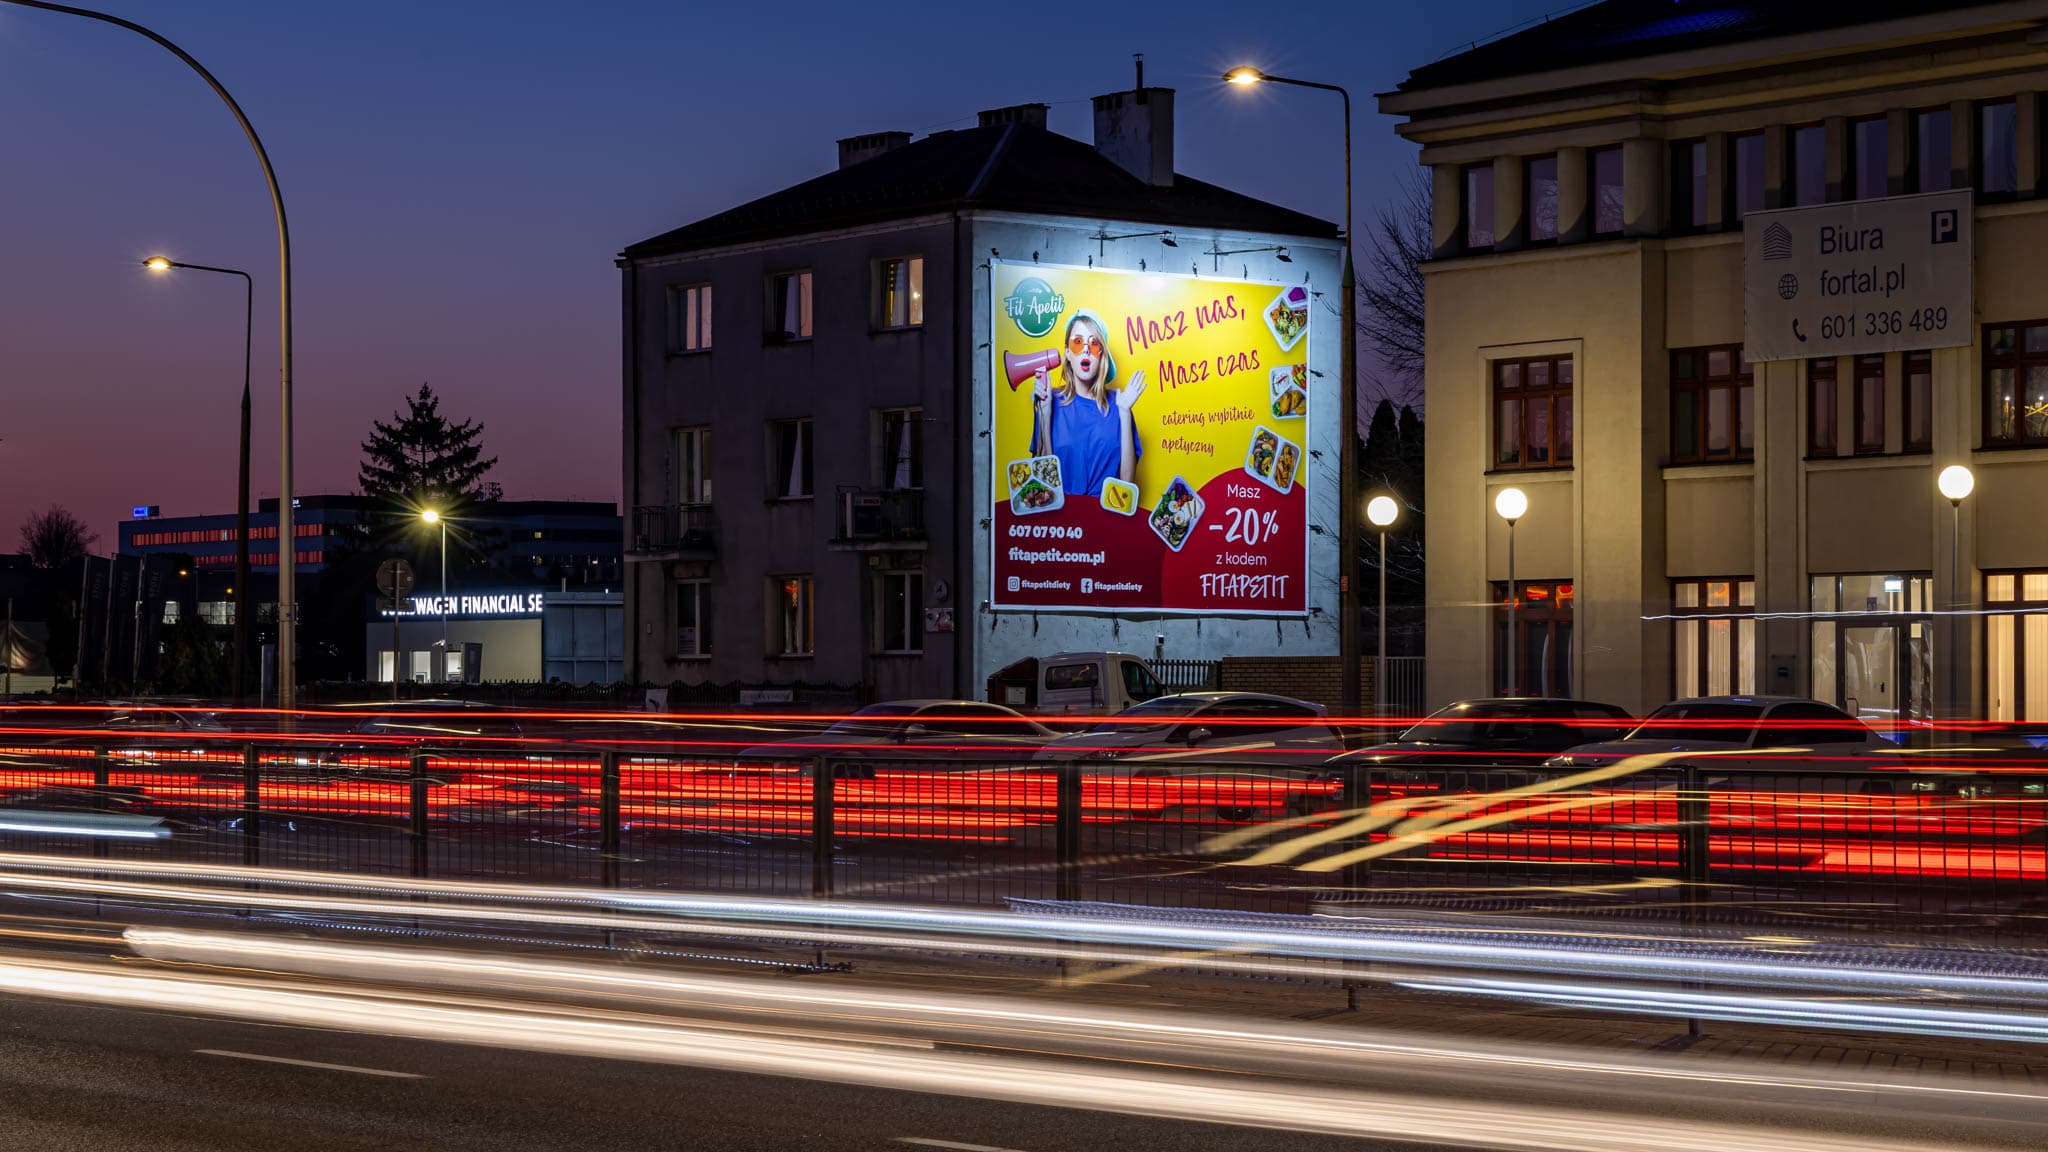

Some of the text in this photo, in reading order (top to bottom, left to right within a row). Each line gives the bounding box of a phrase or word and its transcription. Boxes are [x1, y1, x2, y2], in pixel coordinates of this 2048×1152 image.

[1934, 211, 1954, 242] P
[1820, 225, 1883, 255] Biura
[1820, 263, 1905, 298] fortal.pl
[1006, 295, 1064, 324] Fit Apetit
[1126, 295, 1245, 355] Masz nas,
[1821, 307, 1947, 339] 601 336 489
[1159, 349, 1260, 392] Masz czas
[1162, 408, 1255, 426] catering wybitnie
[1161, 438, 1214, 457] apetyczny
[1227, 483, 1261, 499] Masz
[1009, 525, 1083, 539] 607 07 90 40
[1209, 507, 1279, 545] -20%
[1008, 547, 1105, 566] fitapetit.com.pl
[1216, 552, 1268, 566] z kodem
[1021, 579, 1143, 592] fitapetitdiety fitapetitdiety
[1200, 573, 1290, 599] FITAPETIT
[381, 593, 543, 616] WAGEN FINANCIAL SE
